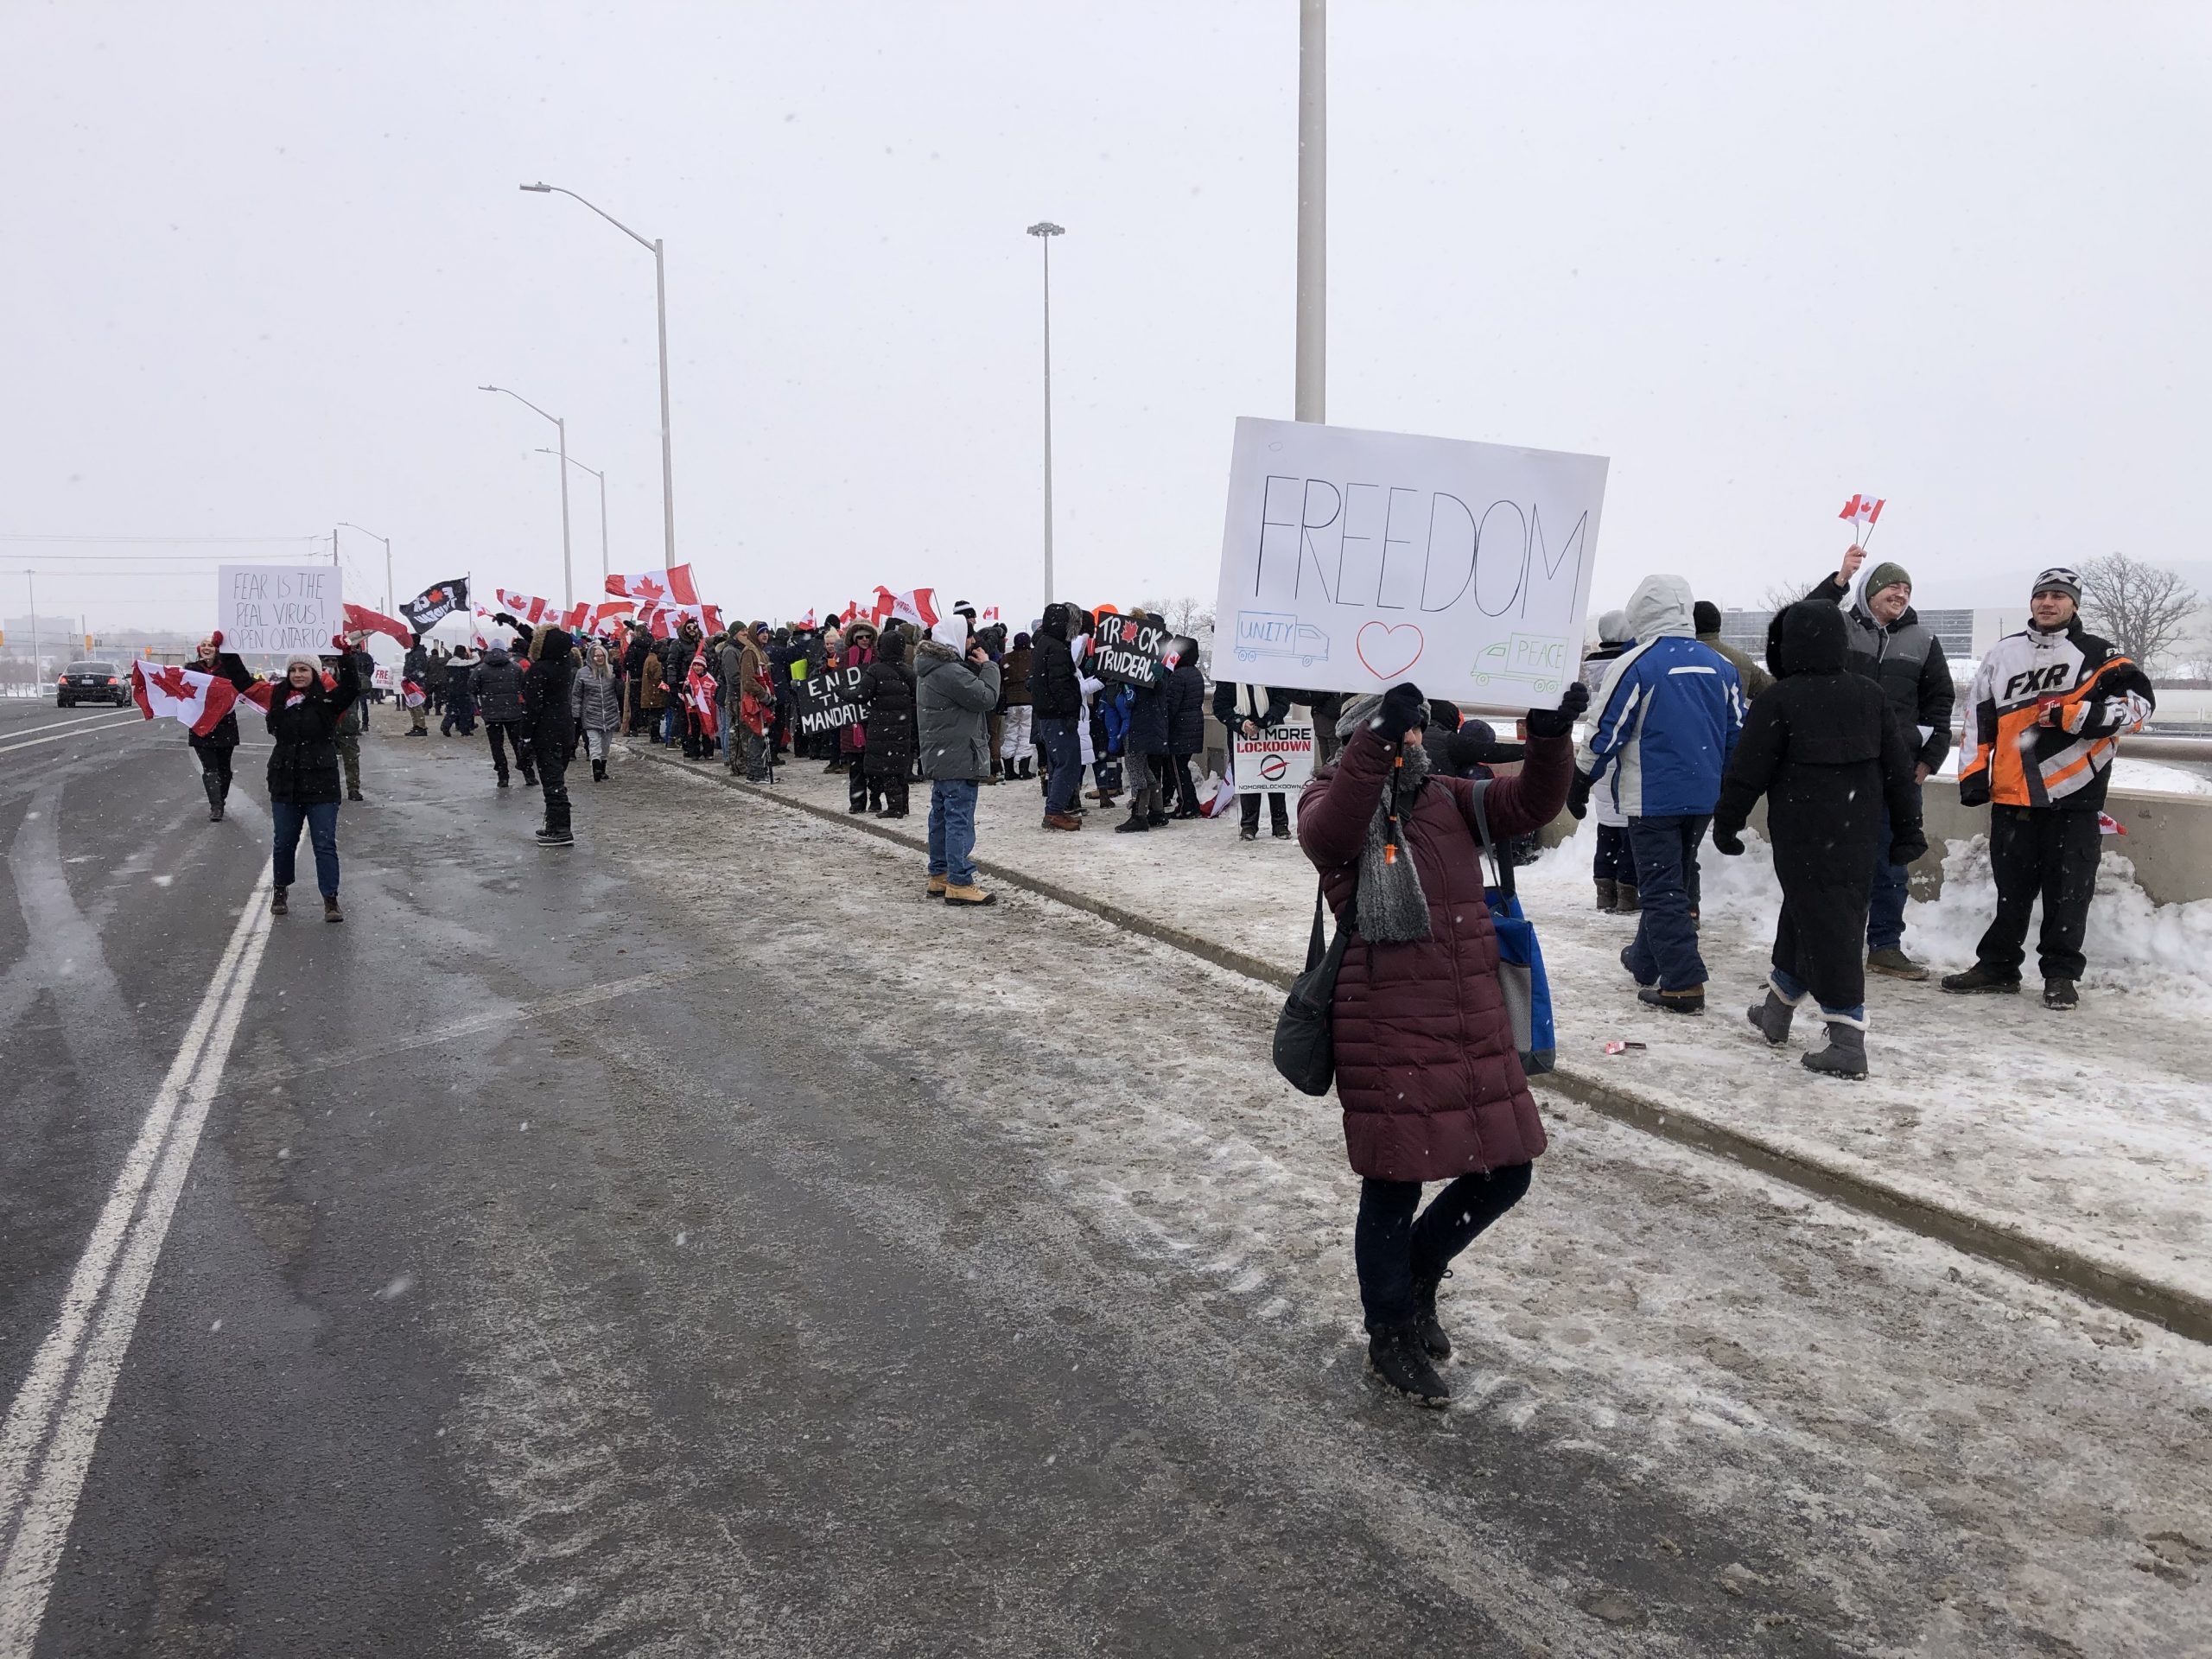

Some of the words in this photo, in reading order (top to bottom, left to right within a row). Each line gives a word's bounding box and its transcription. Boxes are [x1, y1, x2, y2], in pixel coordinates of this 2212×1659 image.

[1255, 474, 1588, 624] FREEDOM
[233, 572, 268, 600] FEAR
[276, 574, 291, 600] IS
[296, 573, 326, 600] THE
[236, 601, 269, 627] REAL
[272, 600, 326, 625] VIRUS!
[228, 627, 264, 651] OPEN
[1098, 615, 1163, 656] TRCK
[1239, 620, 1294, 643] UNITY
[1094, 645, 1157, 683] TRUDEAU
[1515, 639, 1566, 669] PEACE
[807, 666, 861, 696] END
[2003, 663, 2070, 701] FXR
[801, 701, 871, 734] MANDATE
[1236, 741, 1312, 753] LOCKDOWN
[1264, 728, 1312, 741] MORE
